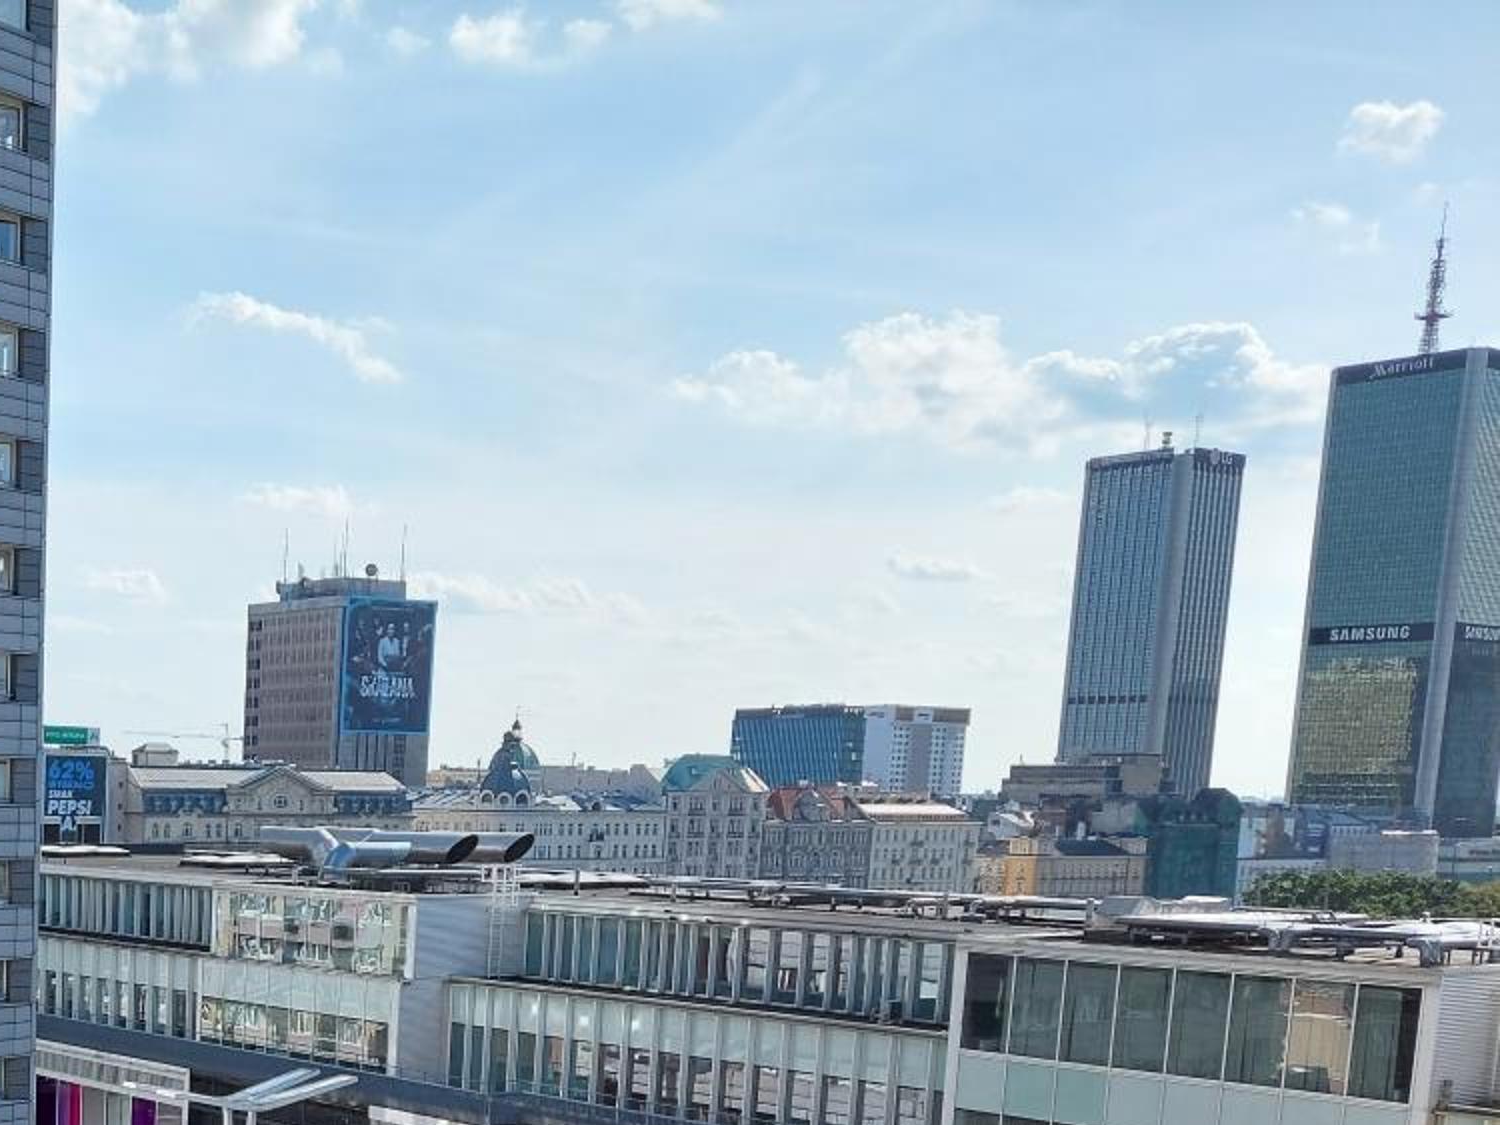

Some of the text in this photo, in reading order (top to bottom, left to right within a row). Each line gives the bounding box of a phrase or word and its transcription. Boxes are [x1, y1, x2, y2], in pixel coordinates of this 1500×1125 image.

[1368, 357, 1434, 379] Marriott
[1329, 625, 1411, 641] SAMSUNG
[49, 759, 95, 780] 62%
[47, 799, 92, 815] PEPSI
